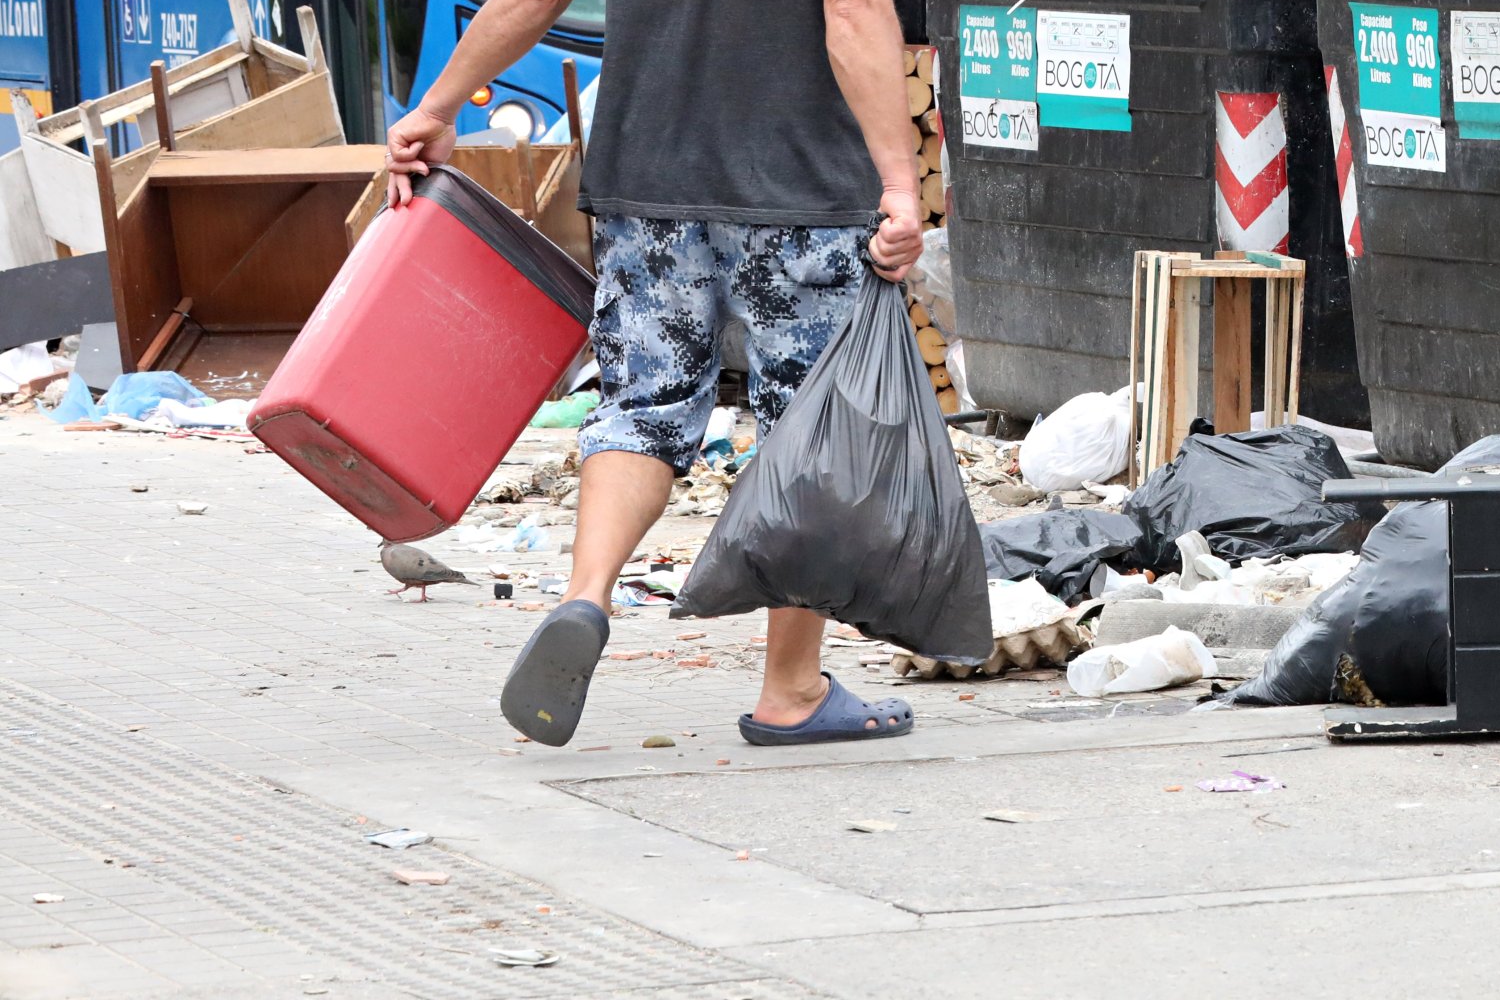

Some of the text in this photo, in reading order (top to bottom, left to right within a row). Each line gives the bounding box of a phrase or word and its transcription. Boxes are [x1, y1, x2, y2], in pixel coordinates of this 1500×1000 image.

[966, 14, 995, 28] Capacidad
[1012, 17, 1027, 29] Peso
[1361, 13, 1392, 29] Capacidad
[1412, 17, 1427, 32] Peso
[962, 27, 1000, 59] 2.400
[1006, 30, 1033, 61] 960
[1358, 28, 1398, 66] 2.400
[1405, 33, 1436, 70] 960
[972, 61, 991, 75] Litros
[1011, 63, 1030, 77] Kilos
[1045, 56, 1121, 91] BOGOTÁ
[1370, 67, 1391, 84] Litros
[1412, 72, 1433, 89] Kilos
[963, 109, 1033, 142] BOGOTÁ
[1366, 123, 1440, 162] BOGOTÁ
